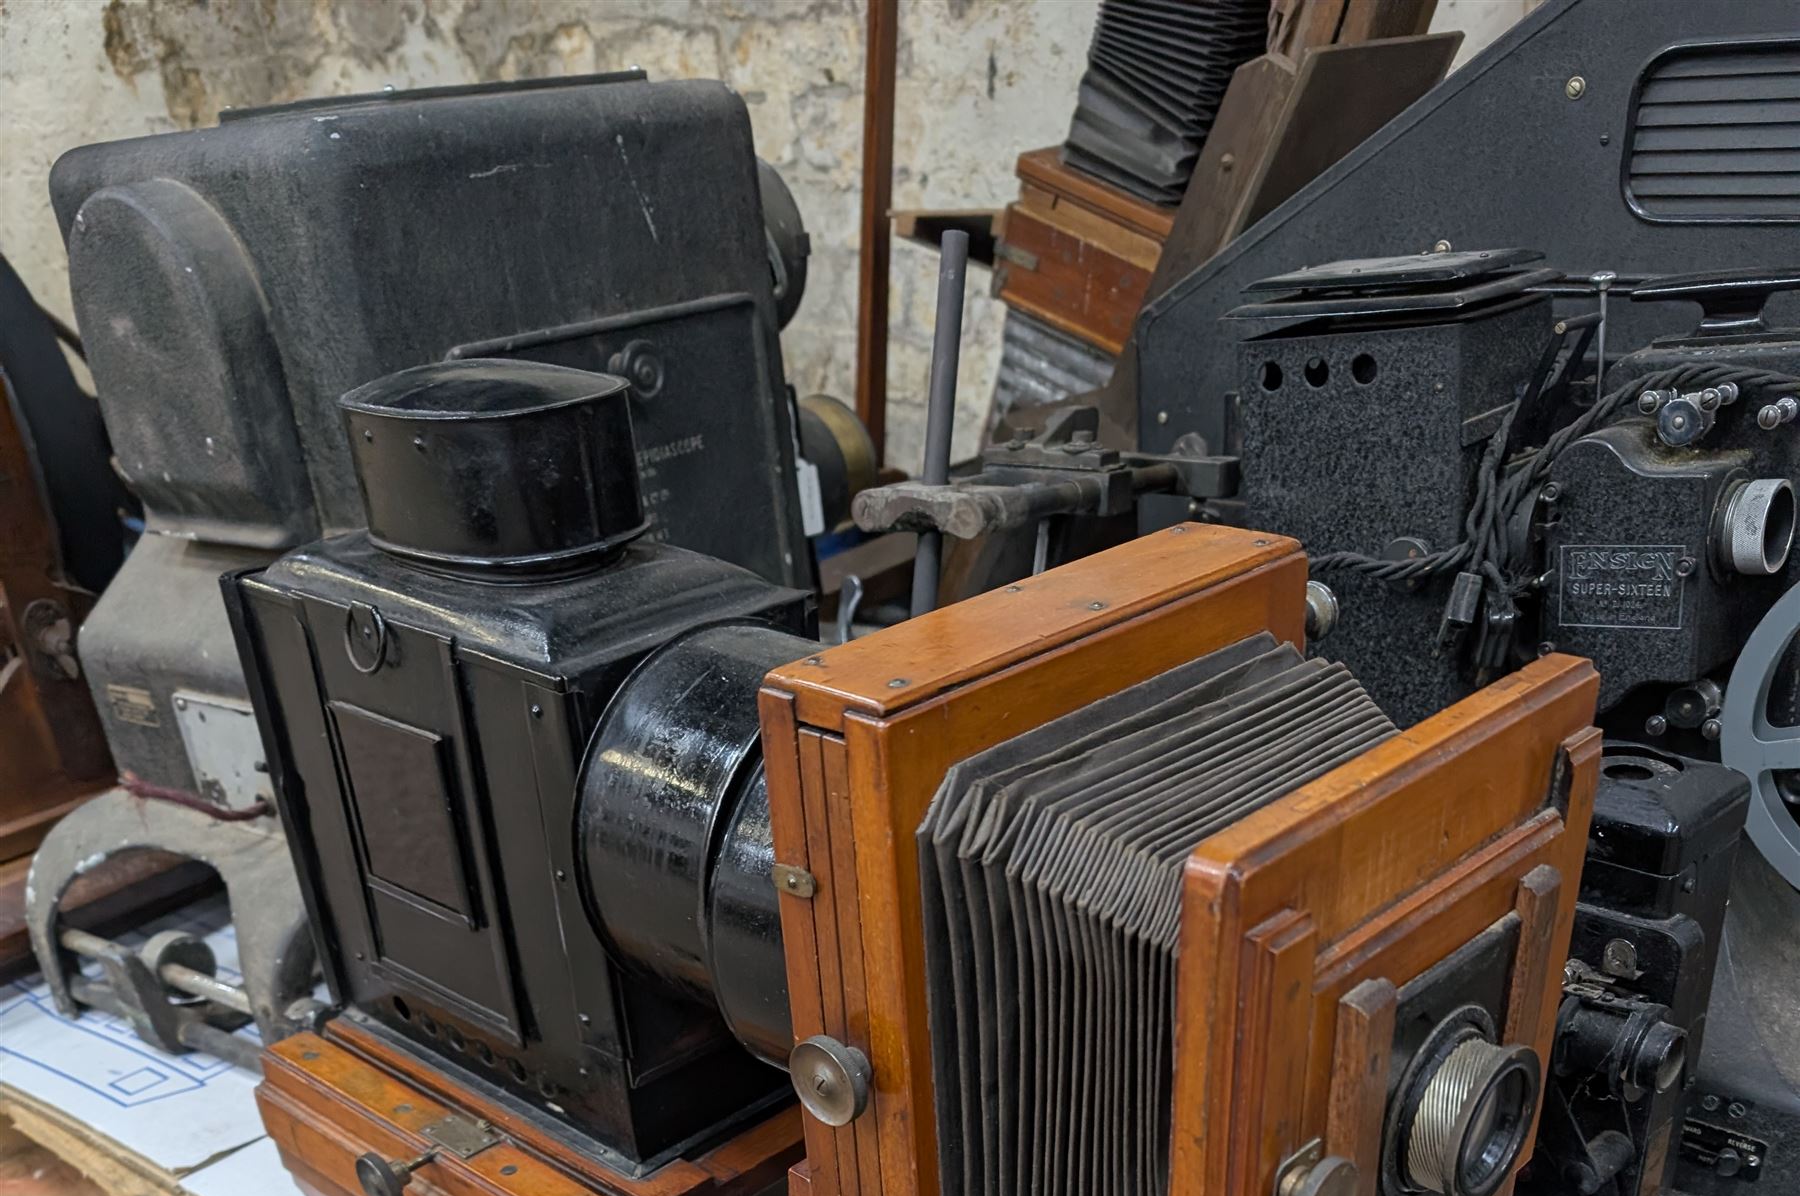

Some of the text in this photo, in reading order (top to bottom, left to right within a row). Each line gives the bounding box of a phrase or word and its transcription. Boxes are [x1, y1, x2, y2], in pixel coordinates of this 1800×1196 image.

[1568, 551, 1675, 581] ENSIGN
[1571, 582, 1671, 598] SUPER-SIXTEEN
[1727, 1138, 1756, 1152] REVERSE
